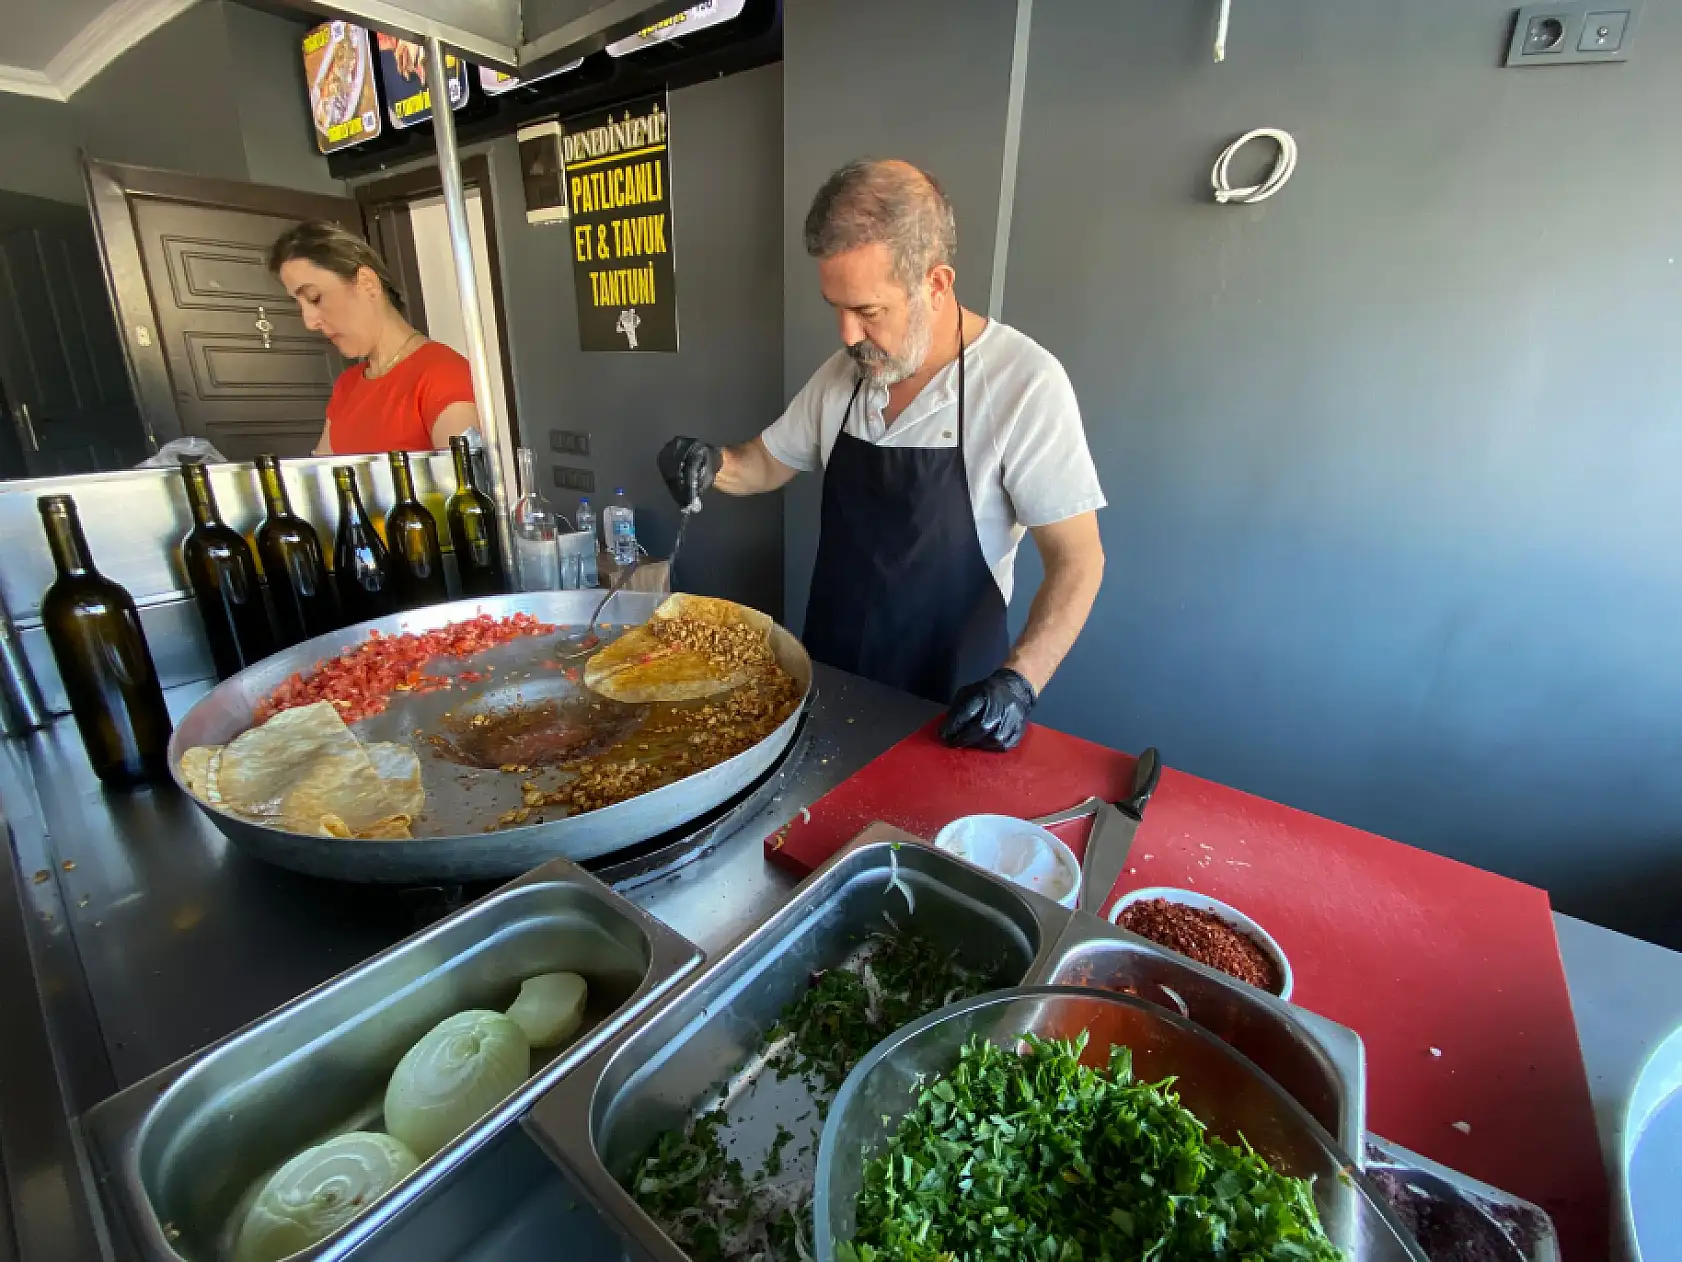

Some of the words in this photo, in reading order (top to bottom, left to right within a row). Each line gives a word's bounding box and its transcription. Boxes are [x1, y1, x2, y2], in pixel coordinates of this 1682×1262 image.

[572, 160, 662, 214] PATLICANLI
[574, 224, 592, 262] ET
[598, 224, 610, 260] &
[611, 214, 667, 258] TAVUK
